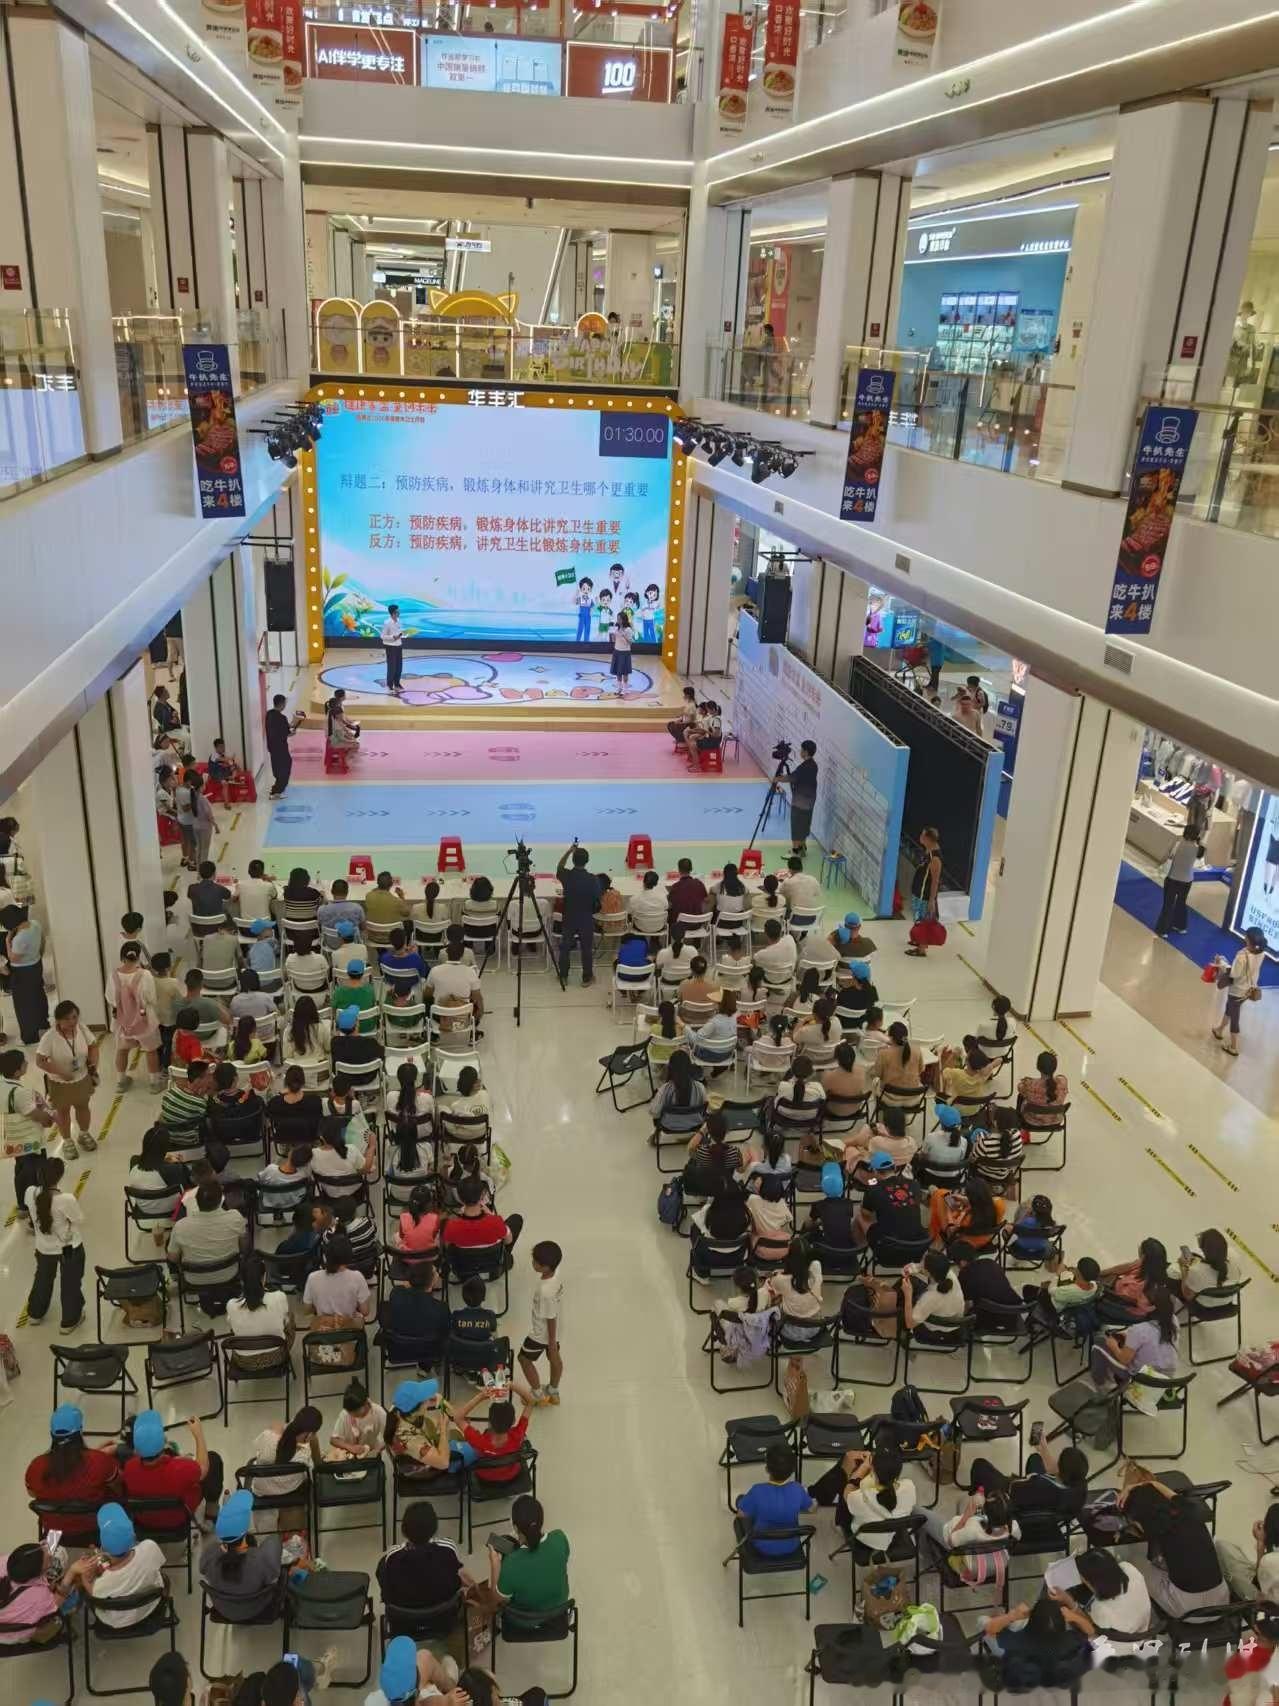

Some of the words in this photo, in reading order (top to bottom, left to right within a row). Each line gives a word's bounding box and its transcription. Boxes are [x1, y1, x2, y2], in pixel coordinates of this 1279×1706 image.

[318, 48, 405, 73] AI伴学更专注
[604, 62, 636, 87] 100
[467, 389, 526, 409] 华丰汇
[200, 479, 241, 492] 吃牛扒
[844, 485, 877, 499] 吃牛扒
[1113, 583, 1155, 600] 吃牛扒
[1110, 601, 1153, 621] 来4楼
